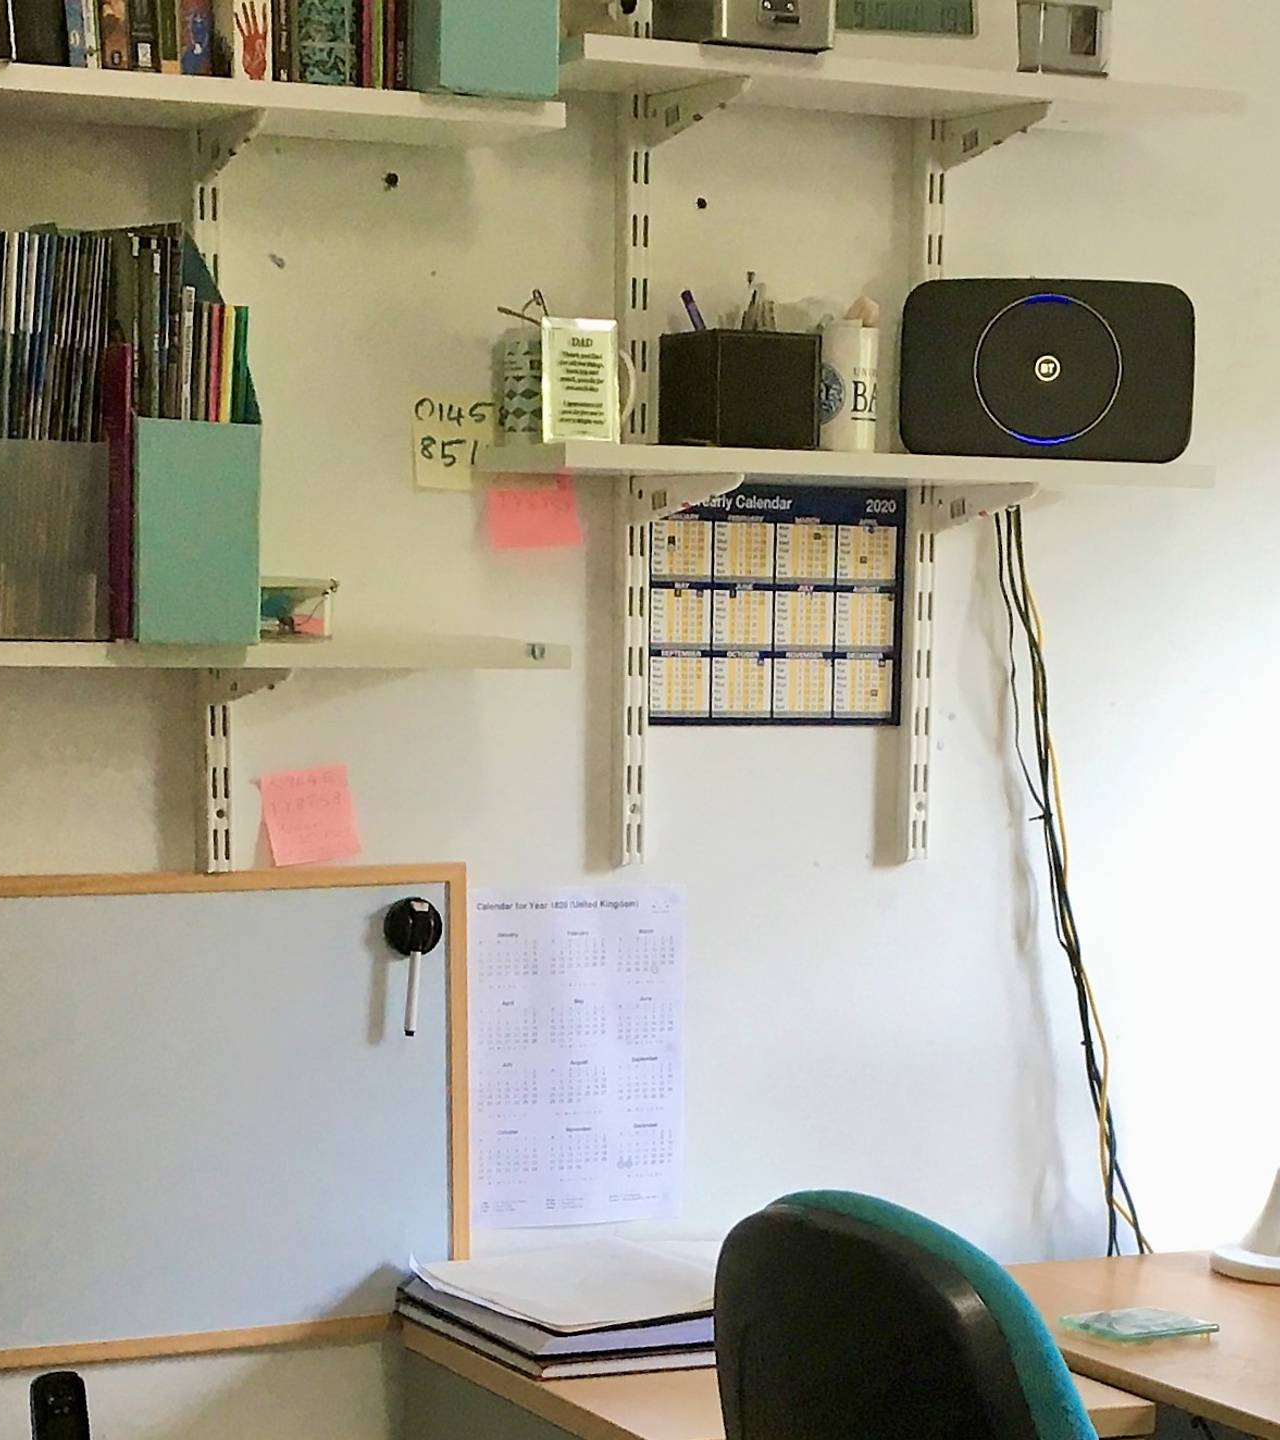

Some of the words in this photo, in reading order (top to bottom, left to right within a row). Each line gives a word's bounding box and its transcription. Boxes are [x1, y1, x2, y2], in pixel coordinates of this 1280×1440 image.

[570, 336, 595, 349] DAD
[735, 493, 793, 511] Calendar
[865, 498, 898, 514] 2020
[476, 901, 514, 911] Calendar
[529, 901, 548, 911] Year
